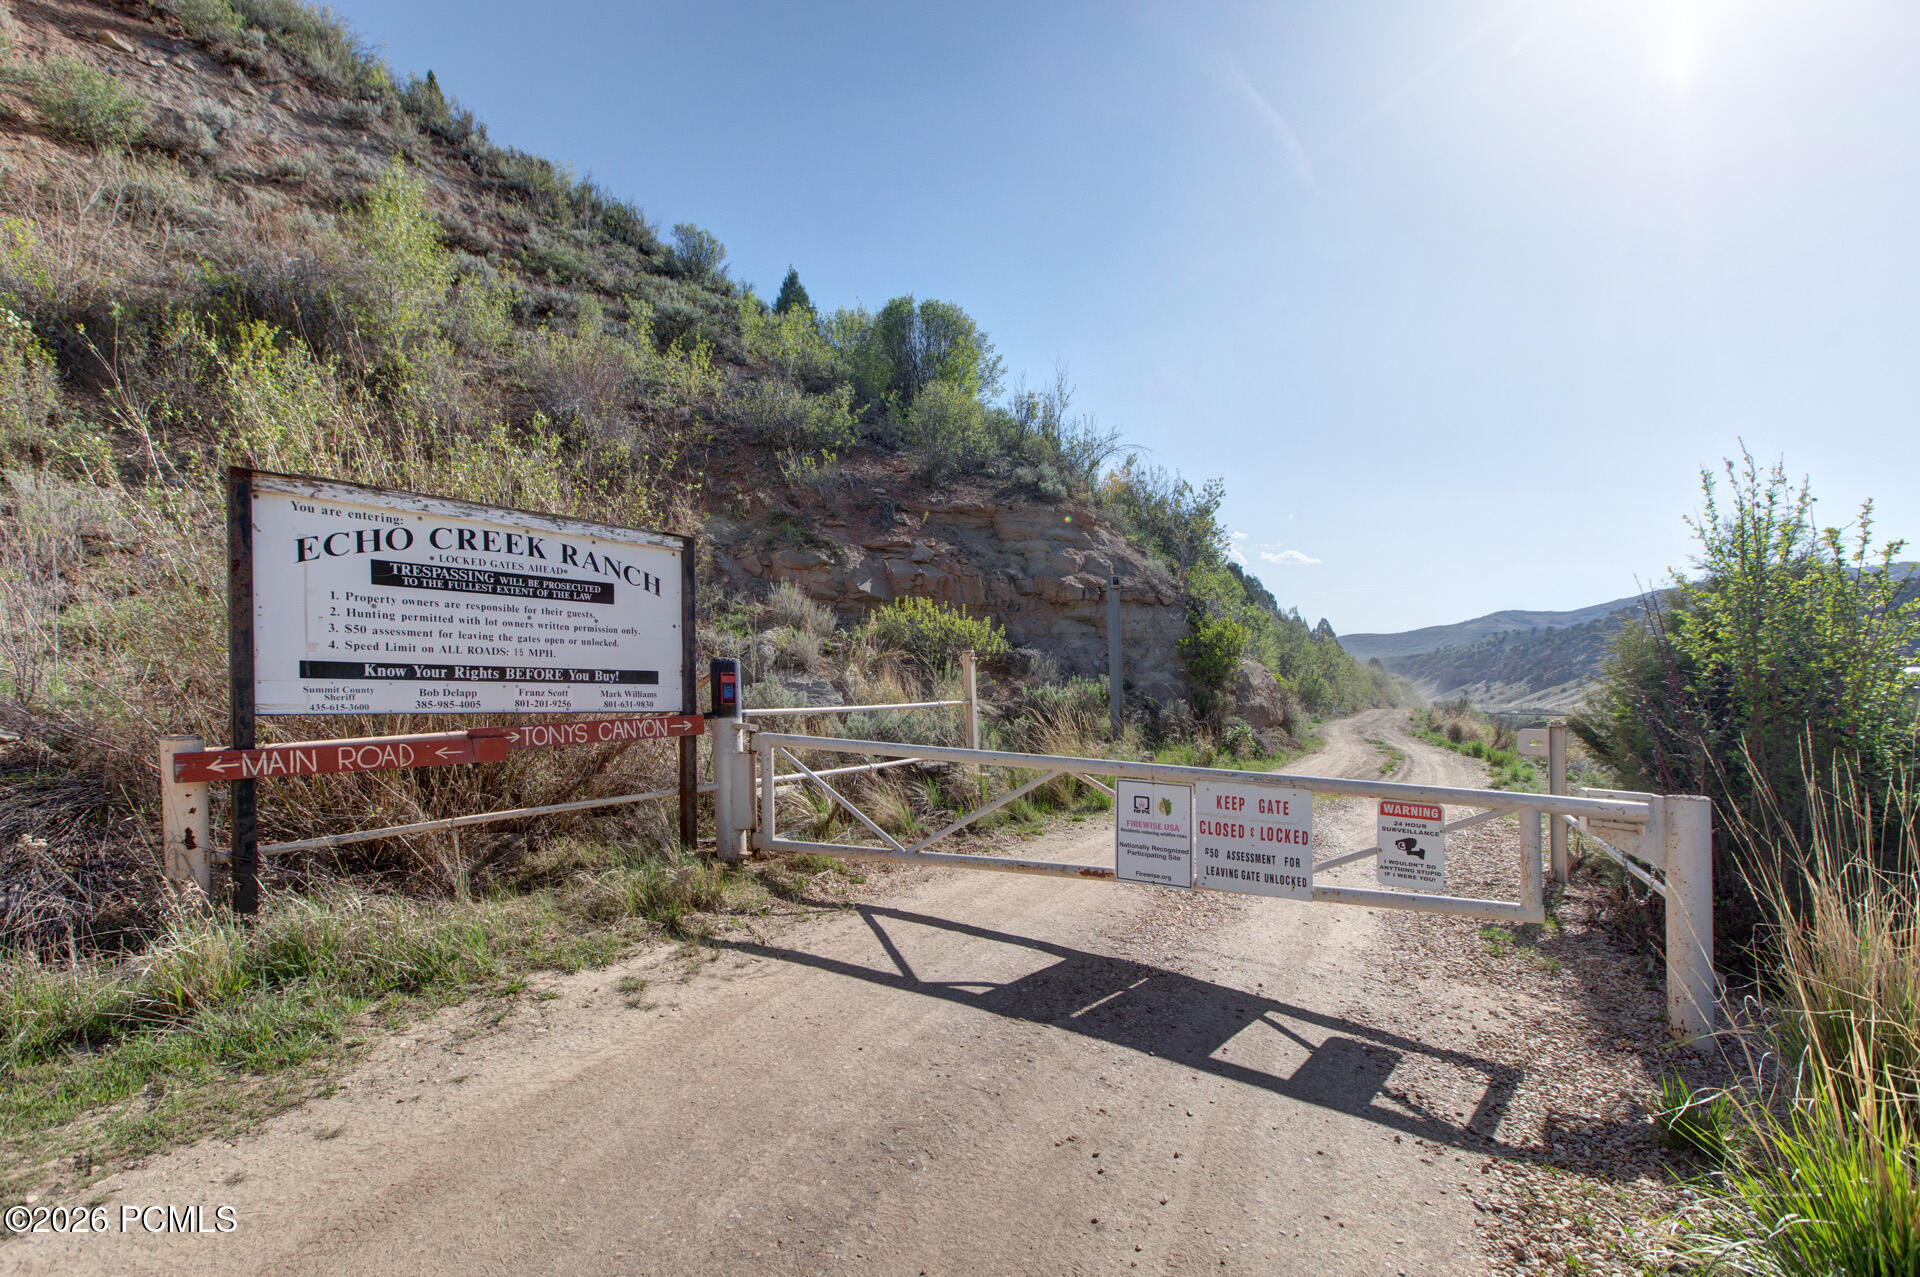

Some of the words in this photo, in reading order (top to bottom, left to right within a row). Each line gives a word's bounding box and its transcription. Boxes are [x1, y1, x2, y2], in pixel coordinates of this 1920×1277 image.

[291, 500, 314, 513] You
[322, 505, 342, 516] are
[348, 511, 404, 525] entering:
[294, 527, 414, 563] ECHO
[430, 527, 546, 560] CREEK
[560, 543, 662, 598] RANCH
[440, 554, 486, 567] LOCKED
[490, 560, 524, 571] GATES
[528, 564, 563, 574] AHEAD
[390, 562, 495, 583] TRESPASSING
[500, 576, 526, 586] WILL
[528, 580, 540, 588] BE
[543, 581, 601, 593] PROSECUTED
[402, 576, 418, 586] TO
[422, 579, 444, 588] THE
[448, 581, 494, 592] FULLEST
[497, 585, 534, 596] EXTENT
[537, 589, 550, 597] OF
[552, 591, 570, 599] THE
[573, 592, 593, 600] LAW
[330, 591, 339, 601] 1.
[345, 592, 396, 606] Property
[402, 598, 439, 608] owners
[444, 600, 461, 609] are
[466, 603, 520, 613] responsible
[524, 606, 537, 615] for
[542, 607, 563, 616] their
[567, 610, 596, 619] guests.
[329, 607, 340, 616] 2.
[346, 608, 396, 621] Hunting
[401, 612, 453, 623] permitted
[459, 616, 480, 625] with
[485, 617, 498, 626] lot
[502, 620, 534, 629] owners
[538, 622, 570, 631] written
[574, 625, 618, 634] permission
[621, 627, 641, 636] only.
[328, 623, 339, 633] 3.
[372, 627, 433, 638] assessment
[438, 630, 453, 639] for
[458, 630, 494, 642] leaving
[498, 633, 513, 641] the
[517, 635, 540, 643] gates
[544, 637, 564, 645] open
[581, 639, 620, 647] unlocked.
[328, 640, 339, 649] 4.
[344, 641, 379, 652] Speed
[385, 642, 416, 652] Limit
[440, 645, 463, 654] ALL
[467, 646, 509, 656] ROADS:
[514, 648, 523, 656] 15
[528, 649, 556, 658] MPH.
[364, 663, 407, 677] Know
[413, 664, 448, 678] Your
[454, 665, 500, 681] Rights
[505, 667, 564, 680] BEFORE
[568, 669, 589, 681] You
[594, 670, 620, 683] Buy!
[302, 686, 340, 694] Summit
[342, 686, 375, 695] County
[419, 688, 439, 697] Bob
[442, 689, 478, 699] Delapp
[519, 688, 545, 697] Franz
[547, 689, 569, 697] Scott
[600, 690, 622, 698] Mark
[624, 690, 657, 698] Williams
[309, 704, 370, 712] 435-615-3600
[415, 701, 482, 710] 385-985-4005
[514, 700, 572, 708] 801-201-9256
[603, 701, 654, 709] 801-631-9830
[520, 724, 588, 747] TONYS
[598, 719, 668, 741] CANYON
[242, 749, 318, 776] MAIN
[338, 744, 414, 770] ROAD
[1216, 795, 1245, 811] KEEP
[1258, 799, 1289, 816] GATE
[1383, 803, 1439, 818] WARNING
[1126, 819, 1162, 831] FIREWISE
[1164, 824, 1180, 832] USA
[1200, 820, 1245, 839] CLOSED
[1260, 826, 1309, 846] LOCKED
[1381, 826, 1440, 837] SURVEILLANCE
[1120, 842, 1150, 851] Nationally
[1152, 845, 1189, 855] Recognized
[1127, 850, 1166, 860] Participating
[1204, 848, 1219, 859] $50
[1226, 850, 1276, 865] ASSESSMENT
[1284, 856, 1301, 868] FOR
[1388, 860, 1424, 868] WOULDN'T
[1136, 870, 1172, 881] Firewise.org
[1206, 866, 1239, 879] LEAVING
[1241, 870, 1260, 882] GATE
[1264, 873, 1307, 888] UNLOCKED
[1380, 865, 1415, 873] ANYTHING
